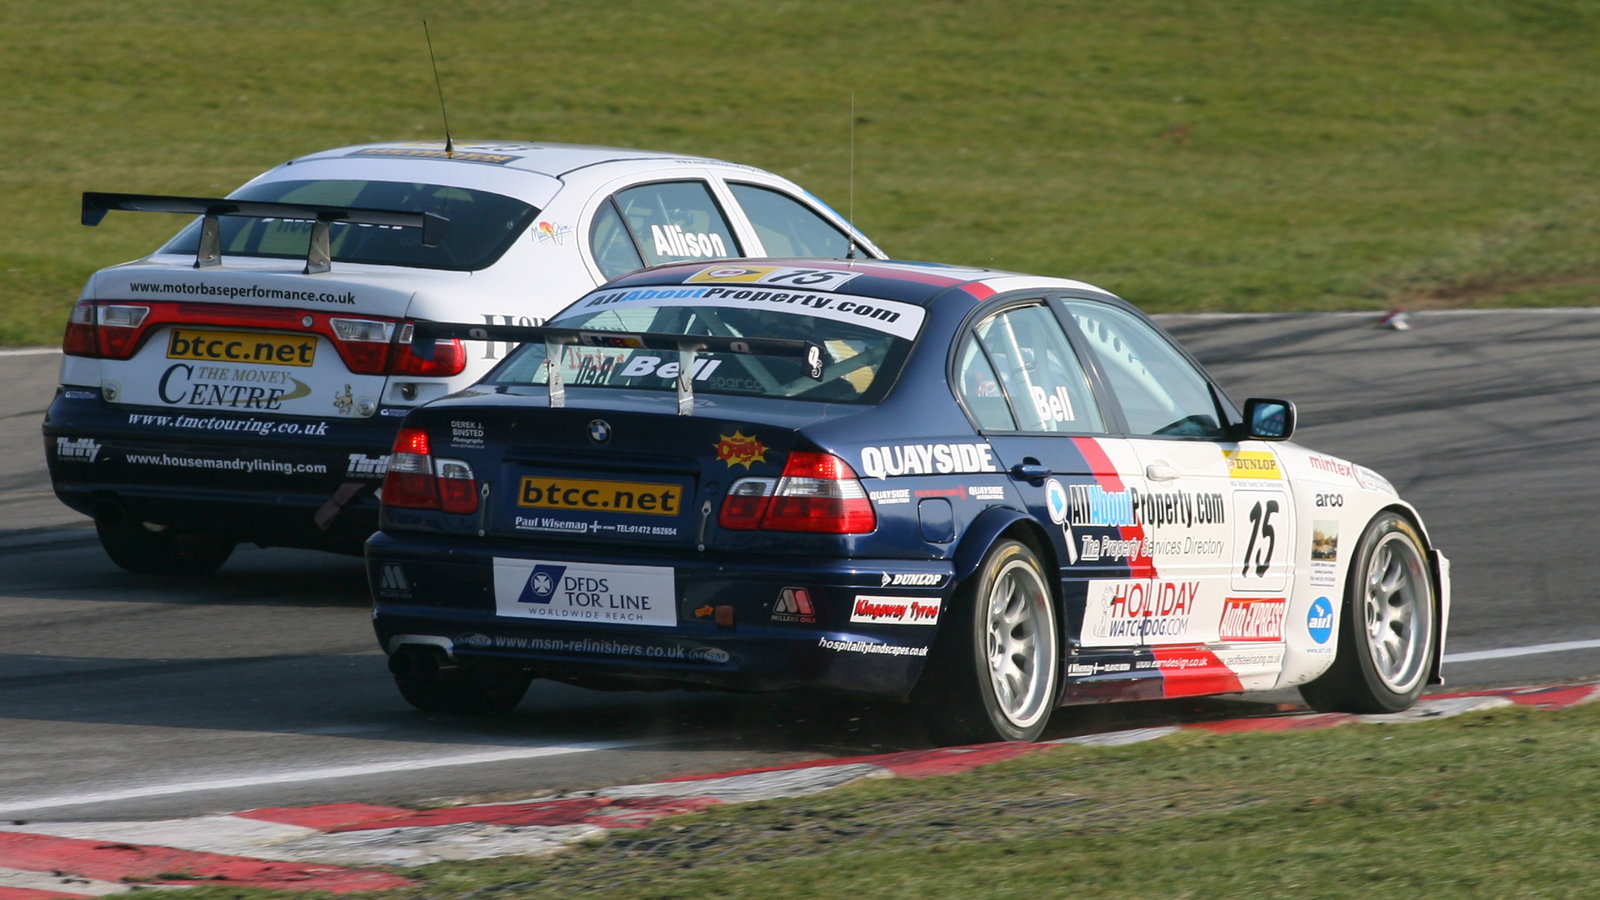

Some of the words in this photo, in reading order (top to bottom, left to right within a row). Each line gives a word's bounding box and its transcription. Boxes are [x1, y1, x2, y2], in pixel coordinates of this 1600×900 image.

[652, 225, 727, 257] Allison
[768, 269, 851, 285] 15
[130, 282, 356, 305] www.motorbaseperformance.co.uk
[585, 286, 901, 323] AllAboutProperty.com
[170, 331, 313, 364] btcc.net
[199, 367, 231, 381] THE
[232, 369, 291, 385] MONEY
[620, 356, 722, 382] Bell
[158, 363, 285, 411] CENTRE
[1031, 386, 1075, 422] Bell
[128, 414, 329, 437] www.tmctouring.co.uk
[451, 420, 476, 428] DEREK
[452, 428, 484, 437] BINSTED
[126, 452, 327, 475] www.housemandrylining.com
[861, 443, 996, 480] QUAYSIDE
[1237, 458, 1276, 470] DUNLOP
[1309, 455, 1354, 479] mintex
[522, 480, 677, 512] btcc.net
[1070, 485, 1225, 528] AllAboutProperty.com
[1315, 493, 1344, 507] arco
[515, 516, 538, 526] Paul
[541, 517, 587, 532] Wiseman
[1081, 535, 1099, 560] The
[1101, 535, 1142, 561] Property
[1142, 536, 1182, 557] Services
[1184, 536, 1225, 559] Directory
[1242, 499, 1279, 579] 15
[564, 576, 609, 593] DFDS
[891, 573, 943, 586] DUNLOP
[565, 592, 604, 608] TOR
[609, 596, 652, 611] LINE
[1111, 581, 1200, 618] HOLIDAY
[529, 608, 600, 619] WORLDWIDE
[606, 612, 643, 621] REACH
[910, 601, 939, 622] Tyres
[1220, 602, 1247, 637] Auto
[1245, 601, 1285, 638] EXPRESS
[1109, 618, 1189, 638] WATCHDOG.COM
[496, 636, 685, 659] www.msm-refinishers.co.uk
[818, 637, 929, 657] hospitalitylandscapes.co.uk
